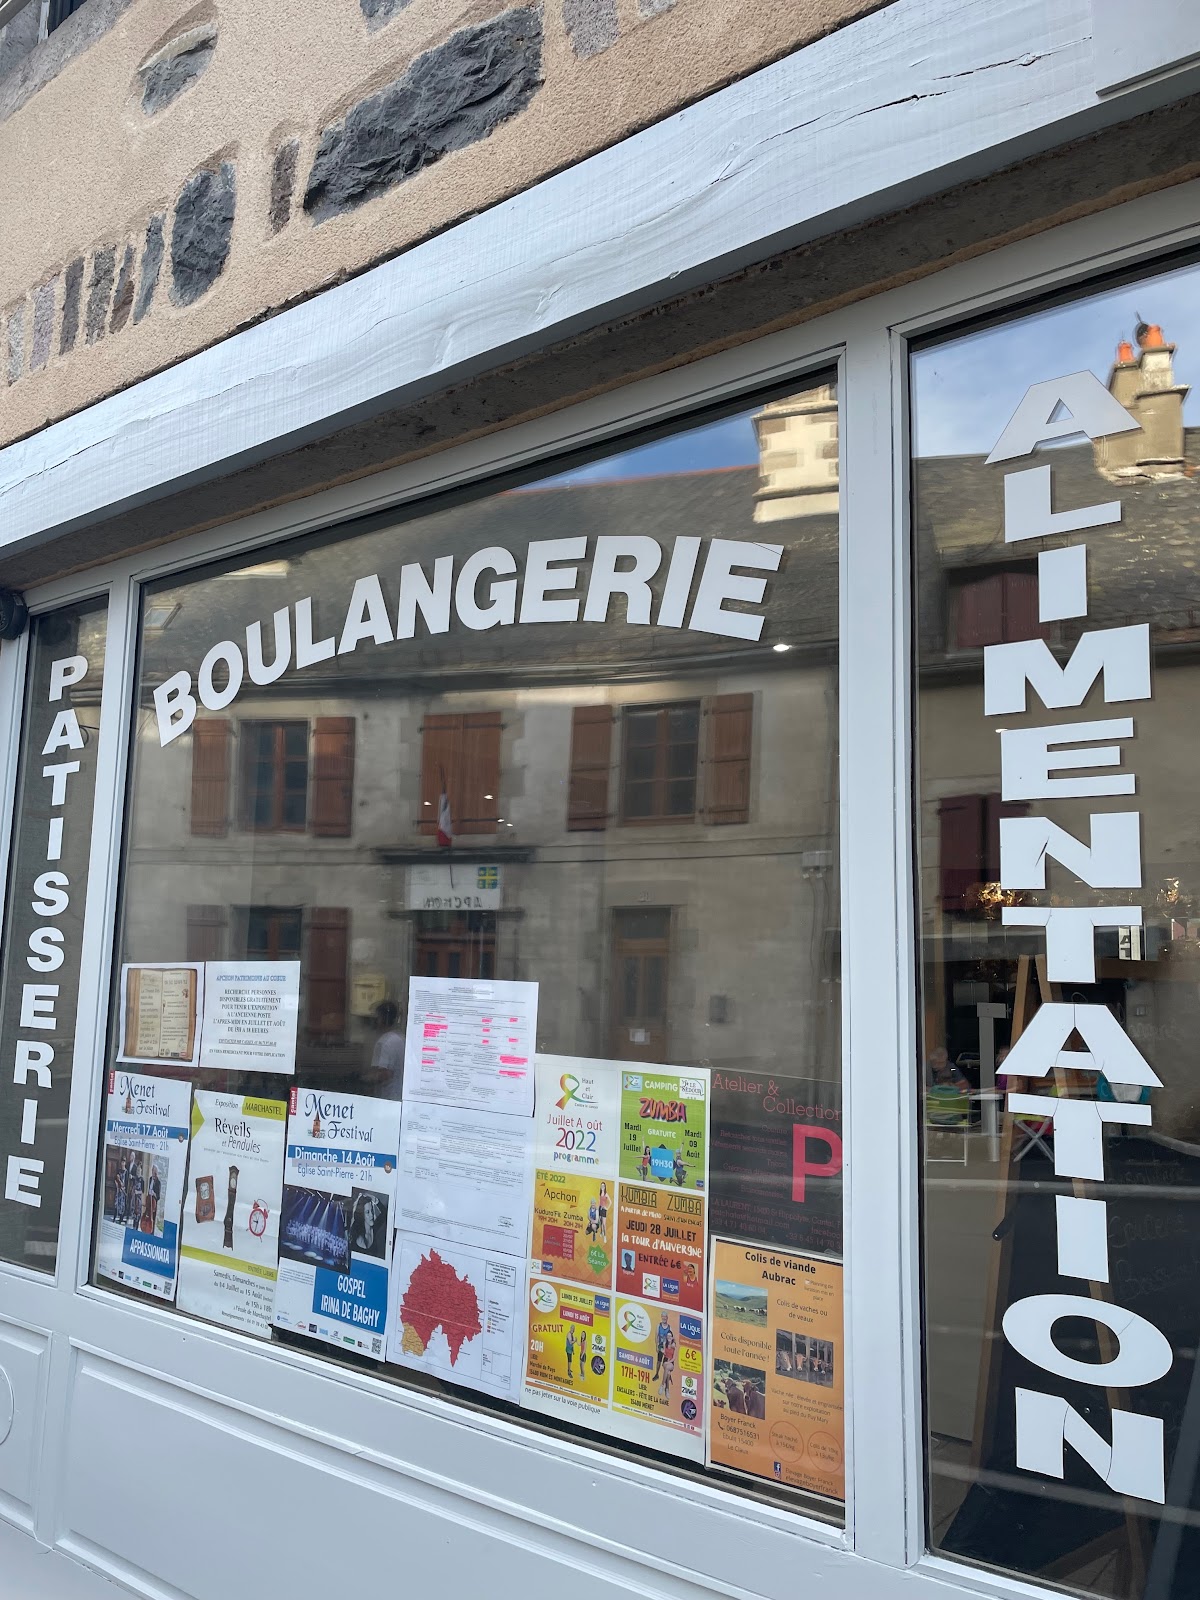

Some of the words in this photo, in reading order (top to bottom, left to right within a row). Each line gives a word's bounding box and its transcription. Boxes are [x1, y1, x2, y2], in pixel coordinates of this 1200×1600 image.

[153, 535, 784, 748] BOULANGERIE
[5, 654, 89, 1208] PATISSERIE
[984, 369, 1174, 1504] ALIMENTATION
[120, 1076, 155, 1098] Menet
[644, 1080, 678, 1091] CAMPING
[712, 1074, 763, 1094] Atelier
[768, 1080, 779, 1096] &
[136, 1099, 170, 1117] Festival
[215, 1099, 239, 1109] Exposition
[245, 1102, 282, 1115] MARCHASTEL
[304, 1094, 354, 1120] Menet
[639, 1098, 687, 1123] ZUMBA
[215, 1118, 251, 1138] Réveils
[547, 1114, 574, 1127] Juillet
[624, 1123, 641, 1131] Mardi
[112, 1122, 140, 1135] Mercredi
[142, 1125, 150, 1136] 17
[152, 1126, 168, 1138] Août
[328, 1121, 374, 1142] Festival
[685, 1130, 702, 1138] Mardi
[228, 1136, 261, 1154] Pendules
[556, 1128, 596, 1152] 2022
[295, 1147, 338, 1163] Dimanche
[342, 1151, 352, 1164] 14
[355, 1152, 376, 1167] Août
[554, 1152, 599, 1164] programme
[686, 1150, 700, 1158] Août
[652, 1158, 673, 1169] 19H30
[792, 1124, 842, 1203] P
[317, 1166, 354, 1180] Saint-Pierre
[360, 1170, 372, 1181] 21h
[536, 1172, 548, 1180] ÉTÉ
[550, 1174, 566, 1183] 2022
[544, 1188, 576, 1202] Apchon
[667, 1193, 702, 1216] ZUMBA
[564, 1212, 583, 1221] Zumba
[626, 1220, 647, 1233] JEUDI
[650, 1224, 661, 1235] 28
[664, 1227, 696, 1242] JUILLET
[130, 1238, 169, 1264] APPASSIONATA
[670, 1261, 681, 1269] 6€
[745, 1251, 767, 1264] Colis
[770, 1256, 781, 1267] de
[783, 1259, 816, 1274] viande
[232, 1275, 255, 1288] Dimanches
[337, 1275, 366, 1298] GOSPEL
[762, 1270, 796, 1286] Aubrac
[226, 1283, 239, 1293] Juillet
[252, 1290, 262, 1300] Août
[321, 1294, 340, 1315] IRINA
[341, 1301, 350, 1319] DE
[353, 1304, 380, 1328] BAGHY
[776, 1298, 790, 1308] Colis
[792, 1302, 799, 1310] de
[800, 1304, 818, 1315] vaches
[798, 1314, 814, 1323] veaux
[532, 1324, 564, 1333] GRATUIT
[530, 1340, 544, 1352] 20H
[720, 1331, 737, 1342] Colis
[738, 1335, 772, 1350] disponible
[619, 1352, 635, 1361] SAMEDI
[686, 1349, 697, 1360] 6€
[741, 1349, 766, 1361] l'année
[621, 1366, 650, 1384] 17H-19H
[532, 1388, 541, 1397] pas
[541, 1391, 553, 1399] jeter
[578, 1404, 600, 1415] publique
[721, 1414, 736, 1423] Boyer
[738, 1419, 756, 1429] Franck
